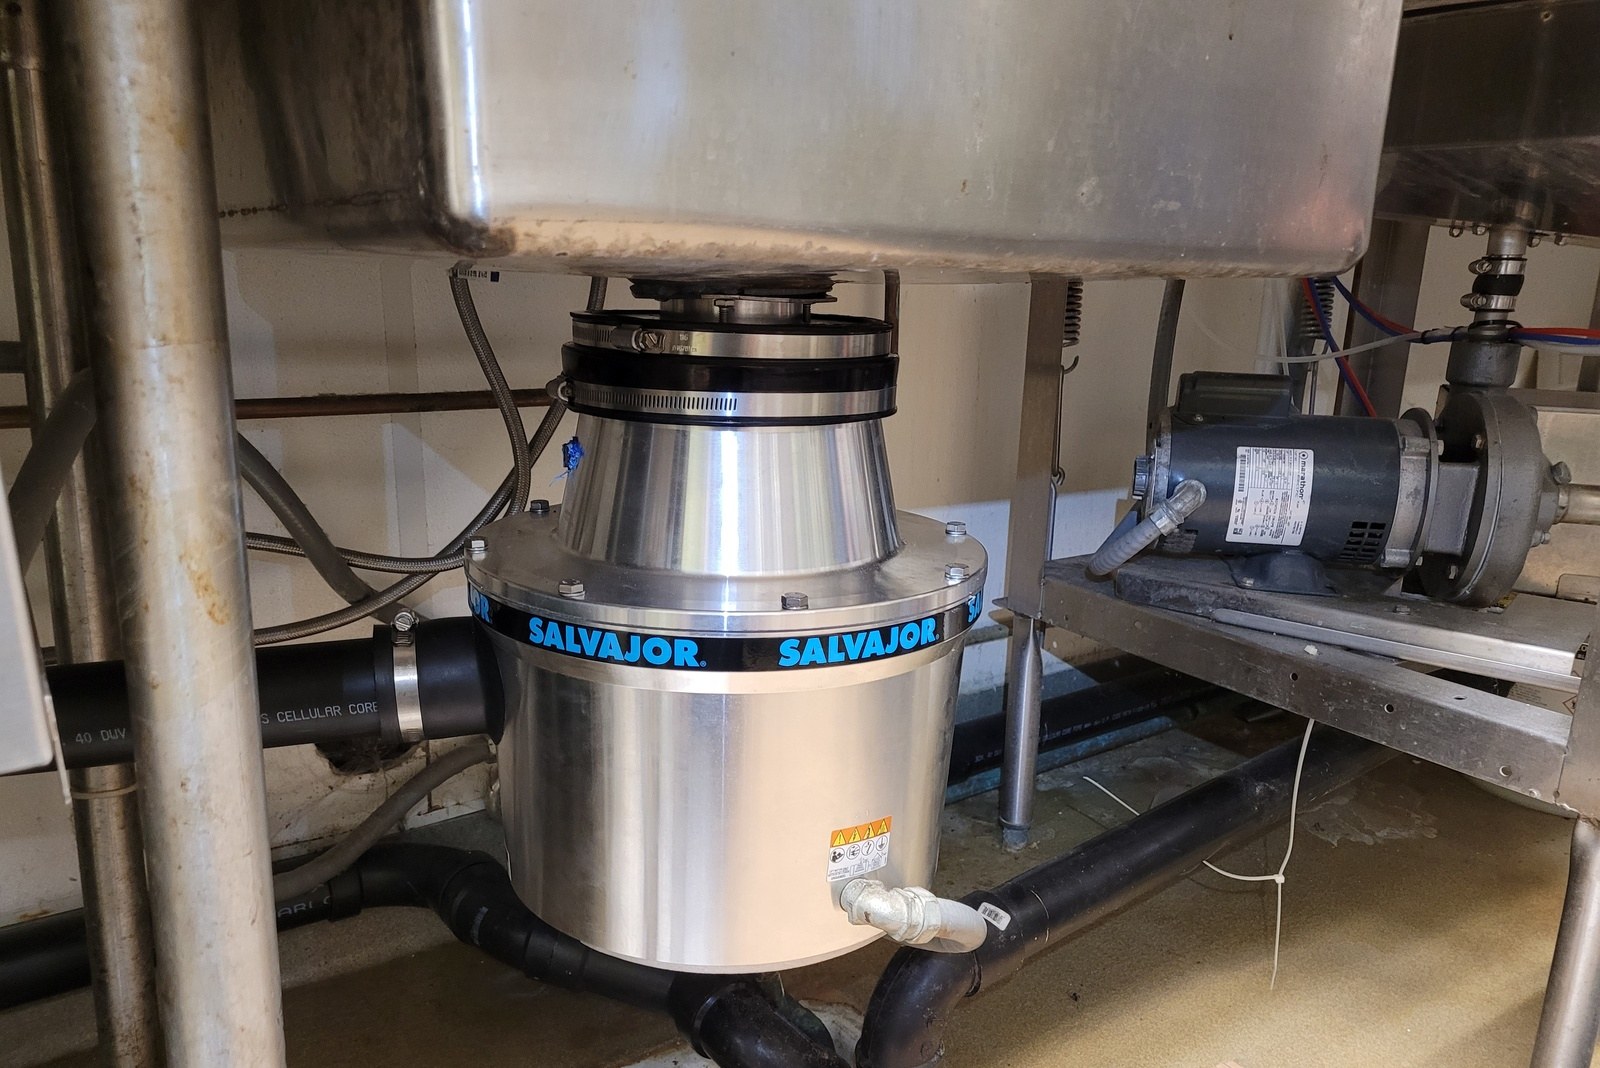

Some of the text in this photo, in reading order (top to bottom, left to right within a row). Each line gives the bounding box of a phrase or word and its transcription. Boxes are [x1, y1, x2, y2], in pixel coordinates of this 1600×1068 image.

[1299, 460, 1307, 499] marathon
[528, 616, 700, 668] SALVAJOR
[778, 617, 936, 667] SALVAJOR
[75, 731, 92, 745] 40
[276, 705, 343, 723] CELLULAR
[348, 701, 379, 715] CORE
